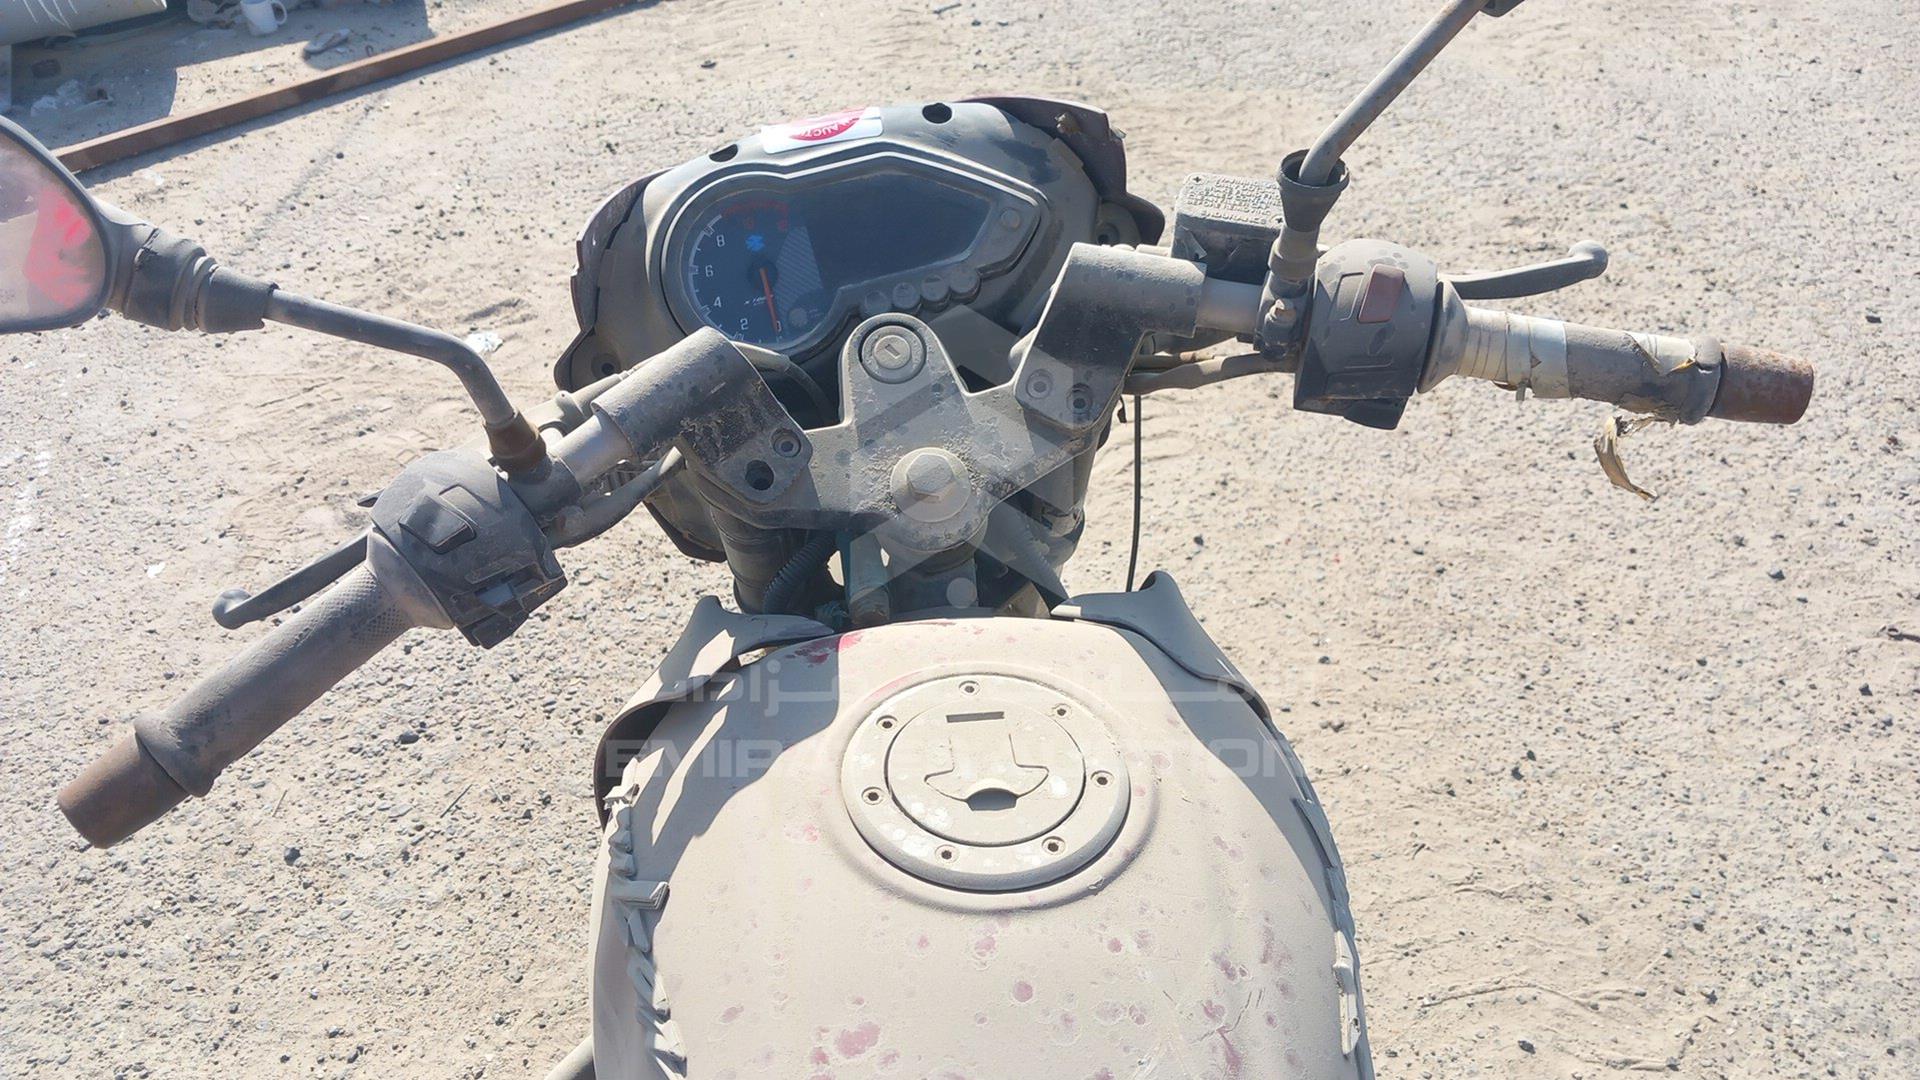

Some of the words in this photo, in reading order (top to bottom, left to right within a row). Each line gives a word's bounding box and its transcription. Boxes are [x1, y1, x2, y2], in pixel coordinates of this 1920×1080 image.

[716, 234, 726, 248] 8
[705, 264, 714, 278] 6
[713, 296, 722, 308] 4
[740, 318, 749, 330] 2
